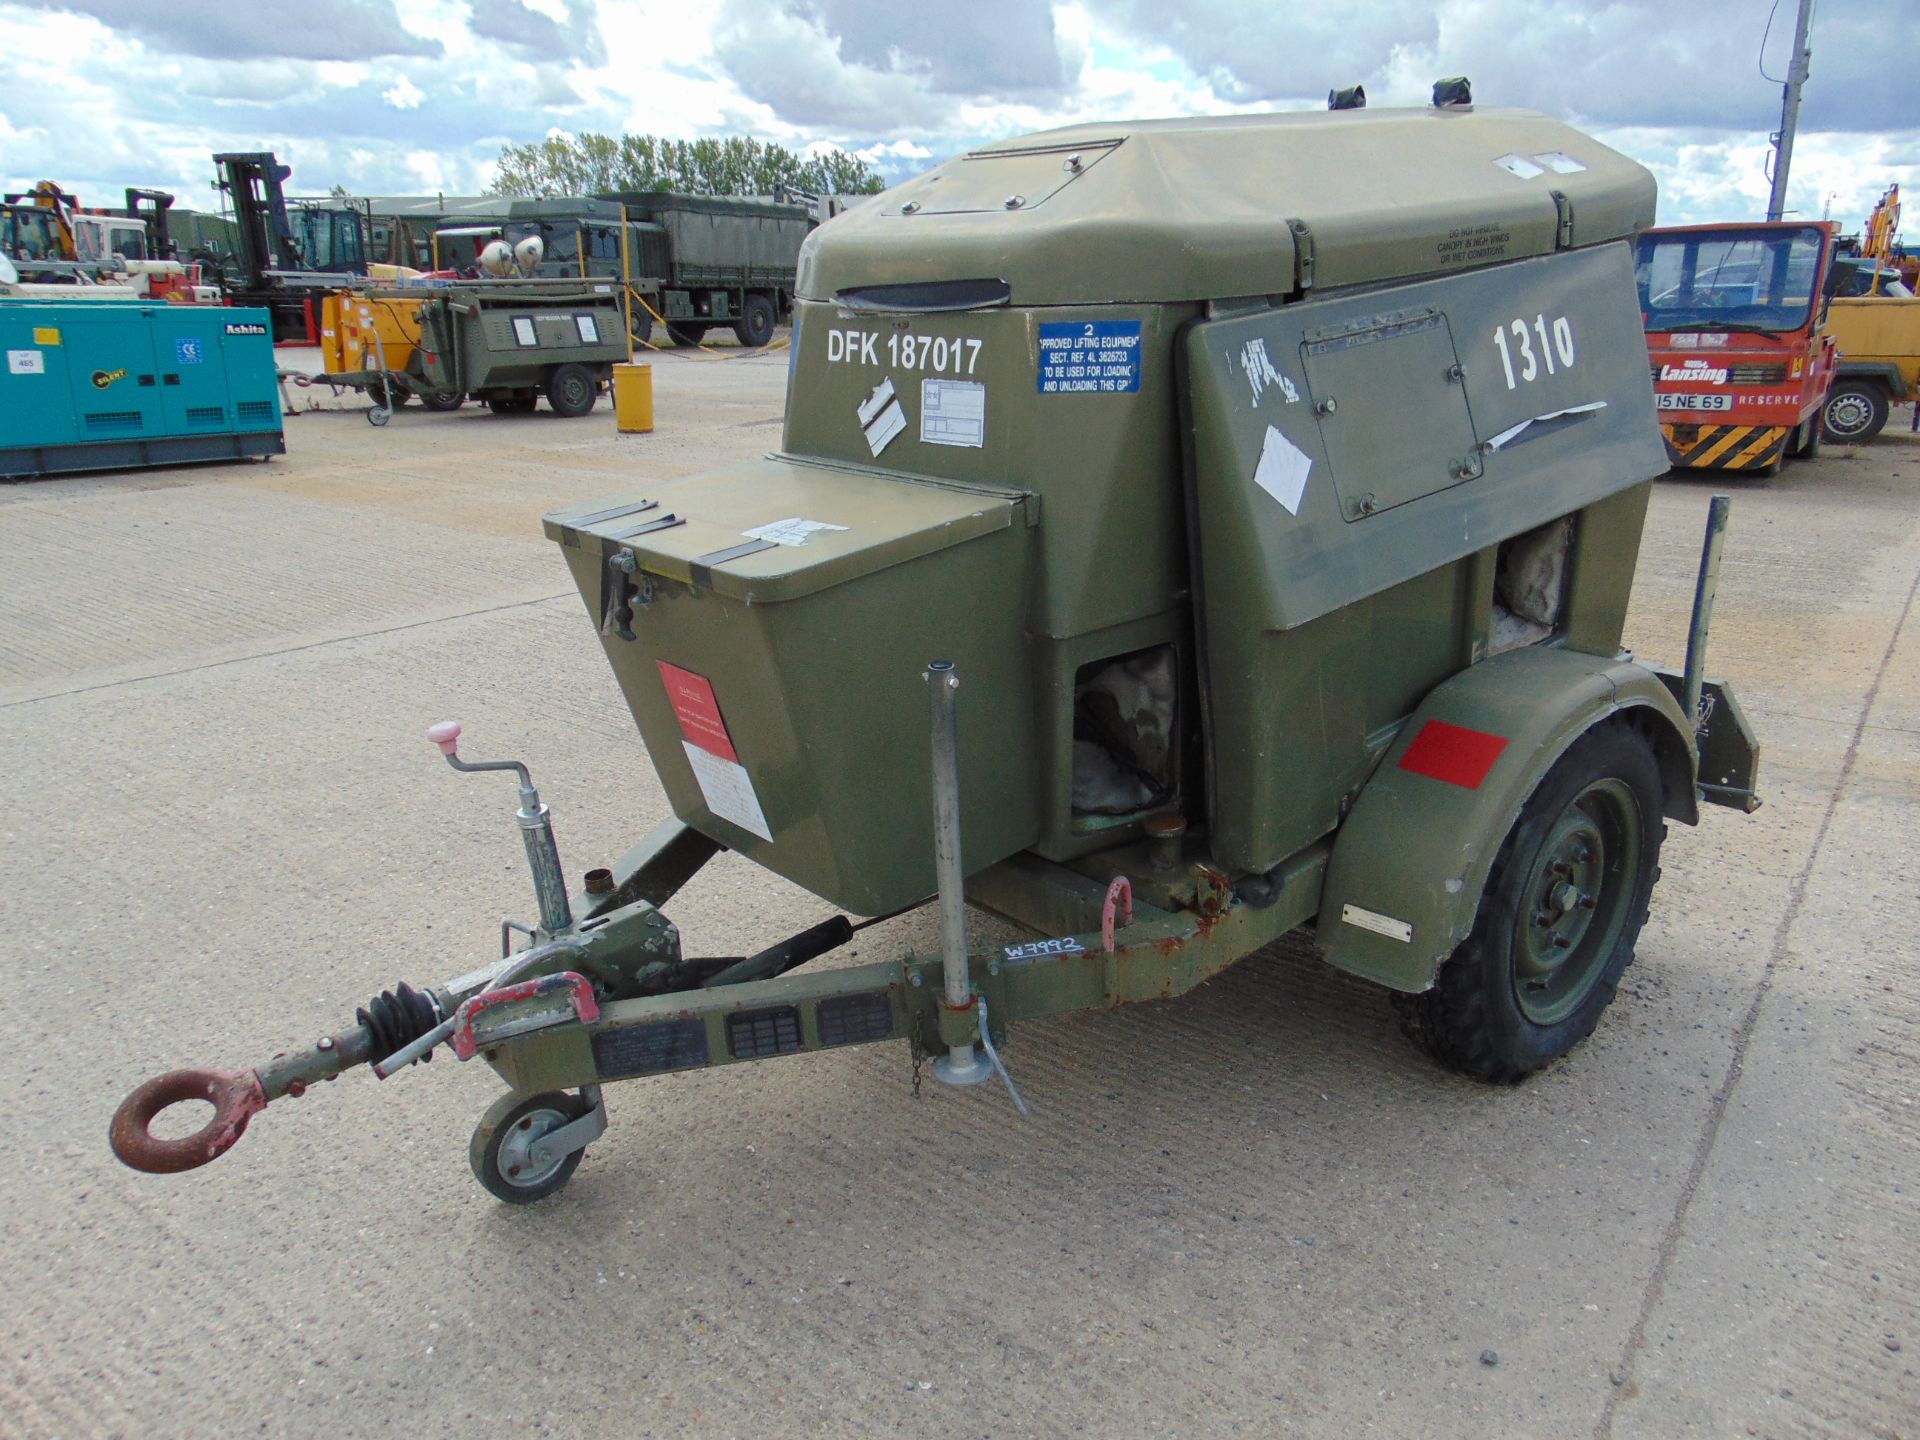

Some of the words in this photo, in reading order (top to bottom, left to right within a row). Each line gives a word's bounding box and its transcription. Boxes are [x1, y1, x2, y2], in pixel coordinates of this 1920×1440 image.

[226, 324, 266, 334] Ashita
[1084, 324, 1093, 336] 2
[1074, 337, 1100, 349] LIFTING
[827, 329, 879, 366] DFK
[887, 333, 983, 374] 187017
[1494, 314, 1574, 390] 1310
[1049, 352, 1069, 364] SECT.
[1071, 352, 1086, 363] REF.
[97, 370, 124, 384] SILENT
[1044, 367, 1053, 378] TO
[1055, 366, 1064, 377] BE
[1066, 366, 1085, 377] USED
[1087, 366, 1101, 376] FOR
[1660, 365, 1727, 385] Lansing
[1043, 381, 1058, 392] AND
[1059, 380, 1098, 392] UNLOADING
[1100, 380, 1115, 391] THIS
[1676, 395, 1698, 408] NE
[1702, 396, 1724, 409] 69
[1739, 395, 1800, 405] RESERVE
